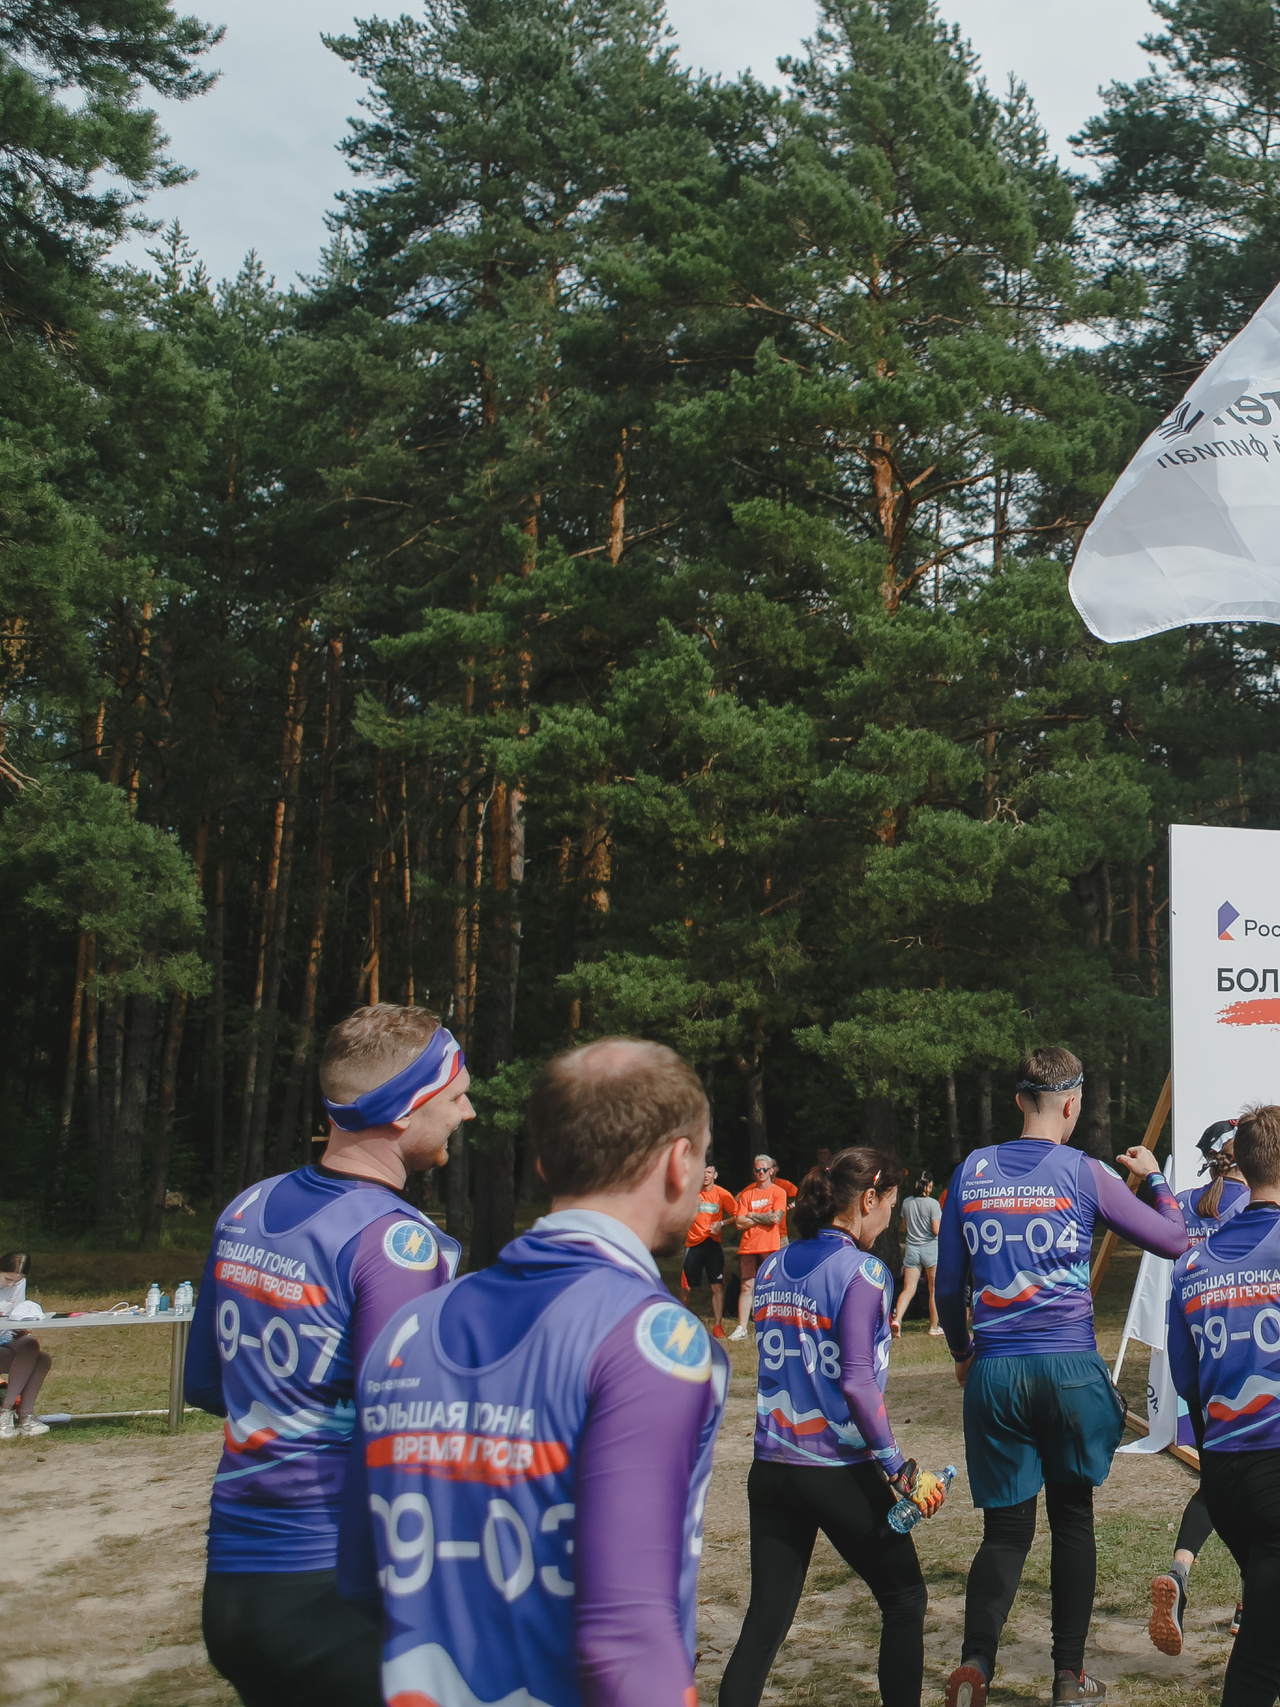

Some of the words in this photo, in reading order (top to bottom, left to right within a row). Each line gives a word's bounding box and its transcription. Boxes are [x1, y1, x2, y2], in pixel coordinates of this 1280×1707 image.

[962, 1186, 1015, 1200] БОЛЬШАЯ
[1017, 1186, 1055, 1197] ГОНКА
[981, 1198, 1015, 1209] ВРЕМЯ
[1017, 1198, 1056, 1208] ГЕРОЕВ
[963, 1218, 1079, 1255] 09-04
[262, 1251, 306, 1280] ГОНКА
[221, 1263, 259, 1286] ВРЕМЯ
[258, 1273, 304, 1301] ГЕРОЕВ
[1182, 1273, 1234, 1300] БОЛЬШАЯ
[1200, 1286, 1236, 1306] ВРЕМЯ
[219, 1300, 343, 1383] 9-07
[755, 1328, 841, 1379] 9-08
[392, 1435, 466, 1463] ВРЕМЯ
